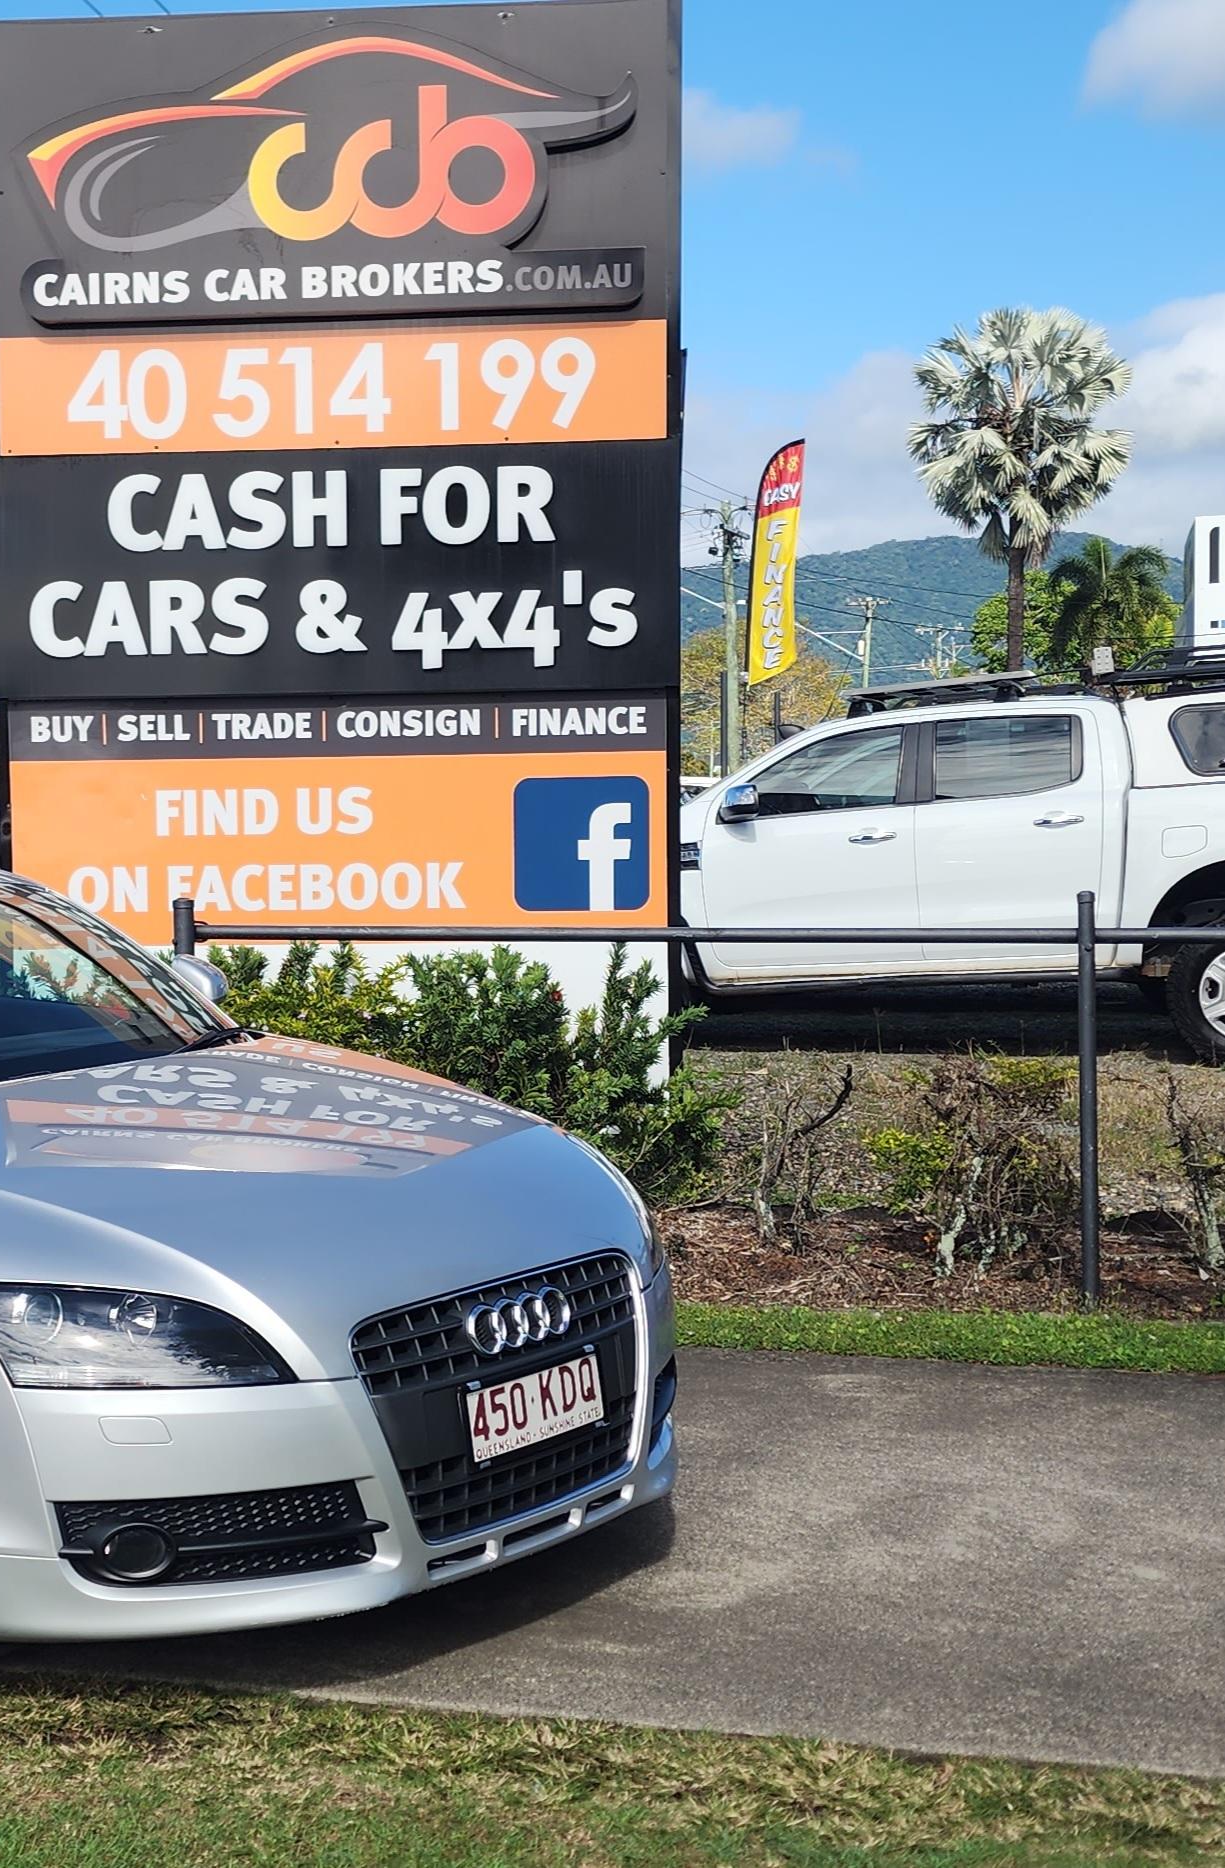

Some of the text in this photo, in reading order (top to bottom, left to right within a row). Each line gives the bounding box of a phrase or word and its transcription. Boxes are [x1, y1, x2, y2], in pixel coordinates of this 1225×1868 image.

[33, 270, 190, 308] CAIRNS
[204, 267, 288, 303] CAR
[67, 336, 597, 441] 40 514 199
[107, 465, 557, 553] CASH FOR
[764, 481, 801, 507] EASY
[29, 578, 270, 659] CARS
[296, 580, 368, 655] &
[762, 518, 788, 671] FINANCE
[31, 707, 648, 744] BUY SELL TRADE CONSIGN FINANCE
[155, 787, 374, 838] FIND US
[67, 862, 466, 914] ON FACEBOOK
[476, 1431, 532, 1459] QUEENSLAND
[539, 1417, 575, 1438] SUNSHINE
[578, 1407, 600, 1423] STATE
